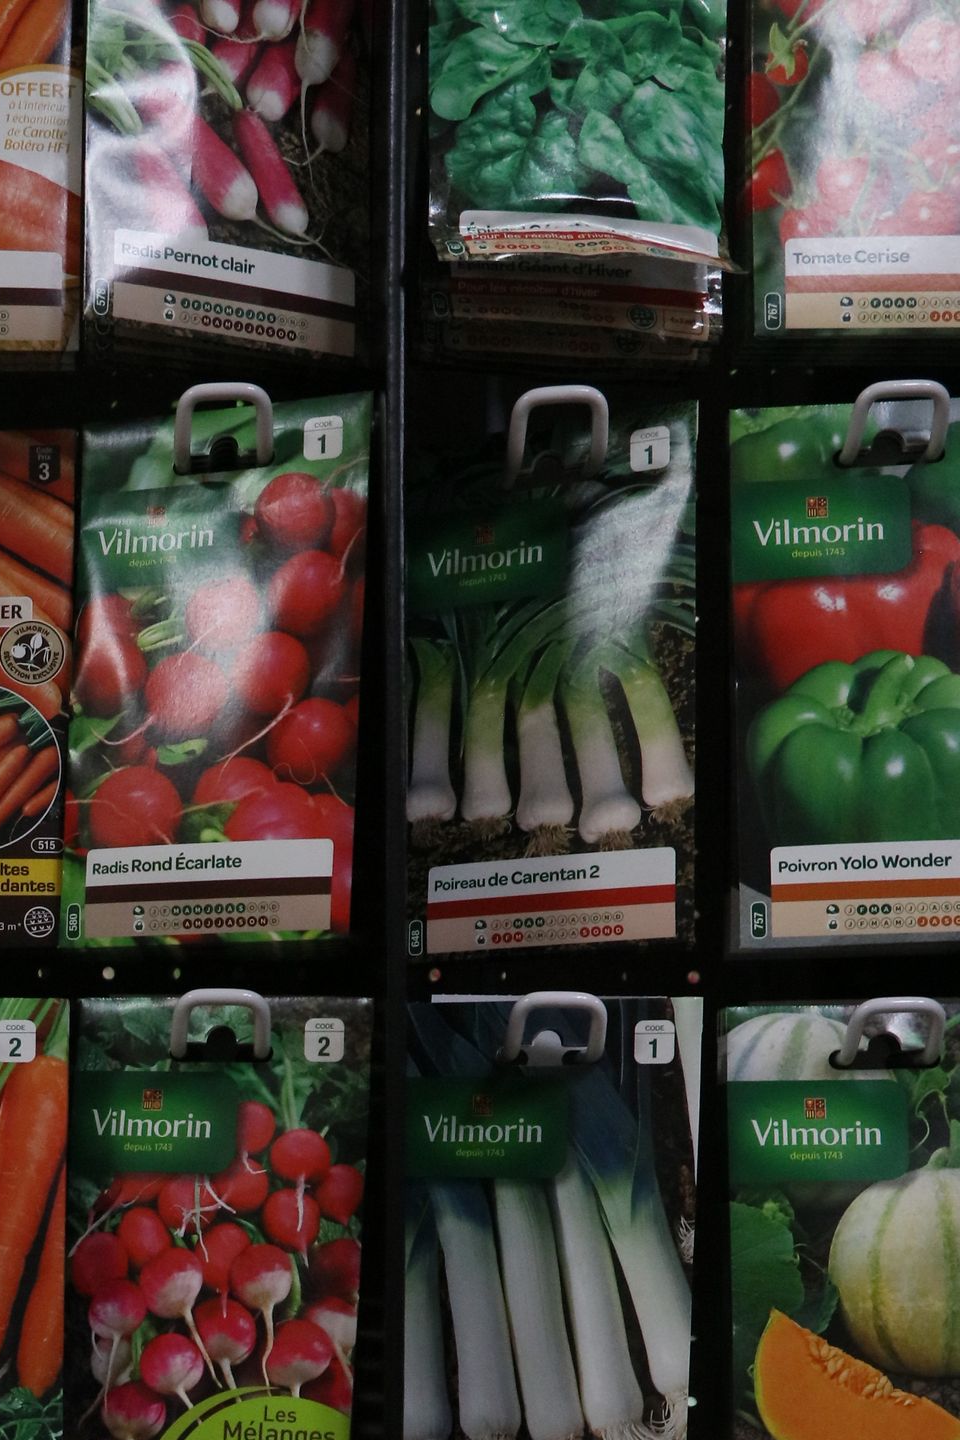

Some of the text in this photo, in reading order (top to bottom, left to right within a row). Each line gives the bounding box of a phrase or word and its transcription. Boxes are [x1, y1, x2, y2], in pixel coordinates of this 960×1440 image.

[122, 242, 255, 274] Radis Pernot clair
[793, 248, 910, 264] Tomate Cerise
[753, 517, 884, 546] Vilmorin
[38, 840, 56, 850] 515
[93, 852, 242, 874] Radis Rond Écarlate
[778, 853, 952, 872] Poivron Yolo Wonder
[434, 865, 600, 892] Poireau de Carentan 2
[92, 1107, 211, 1138] Vilmorin
[424, 1113, 542, 1143] Vilmorin
[751, 1117, 881, 1146] Vilmorin
[263, 1405, 296, 1422] Les
